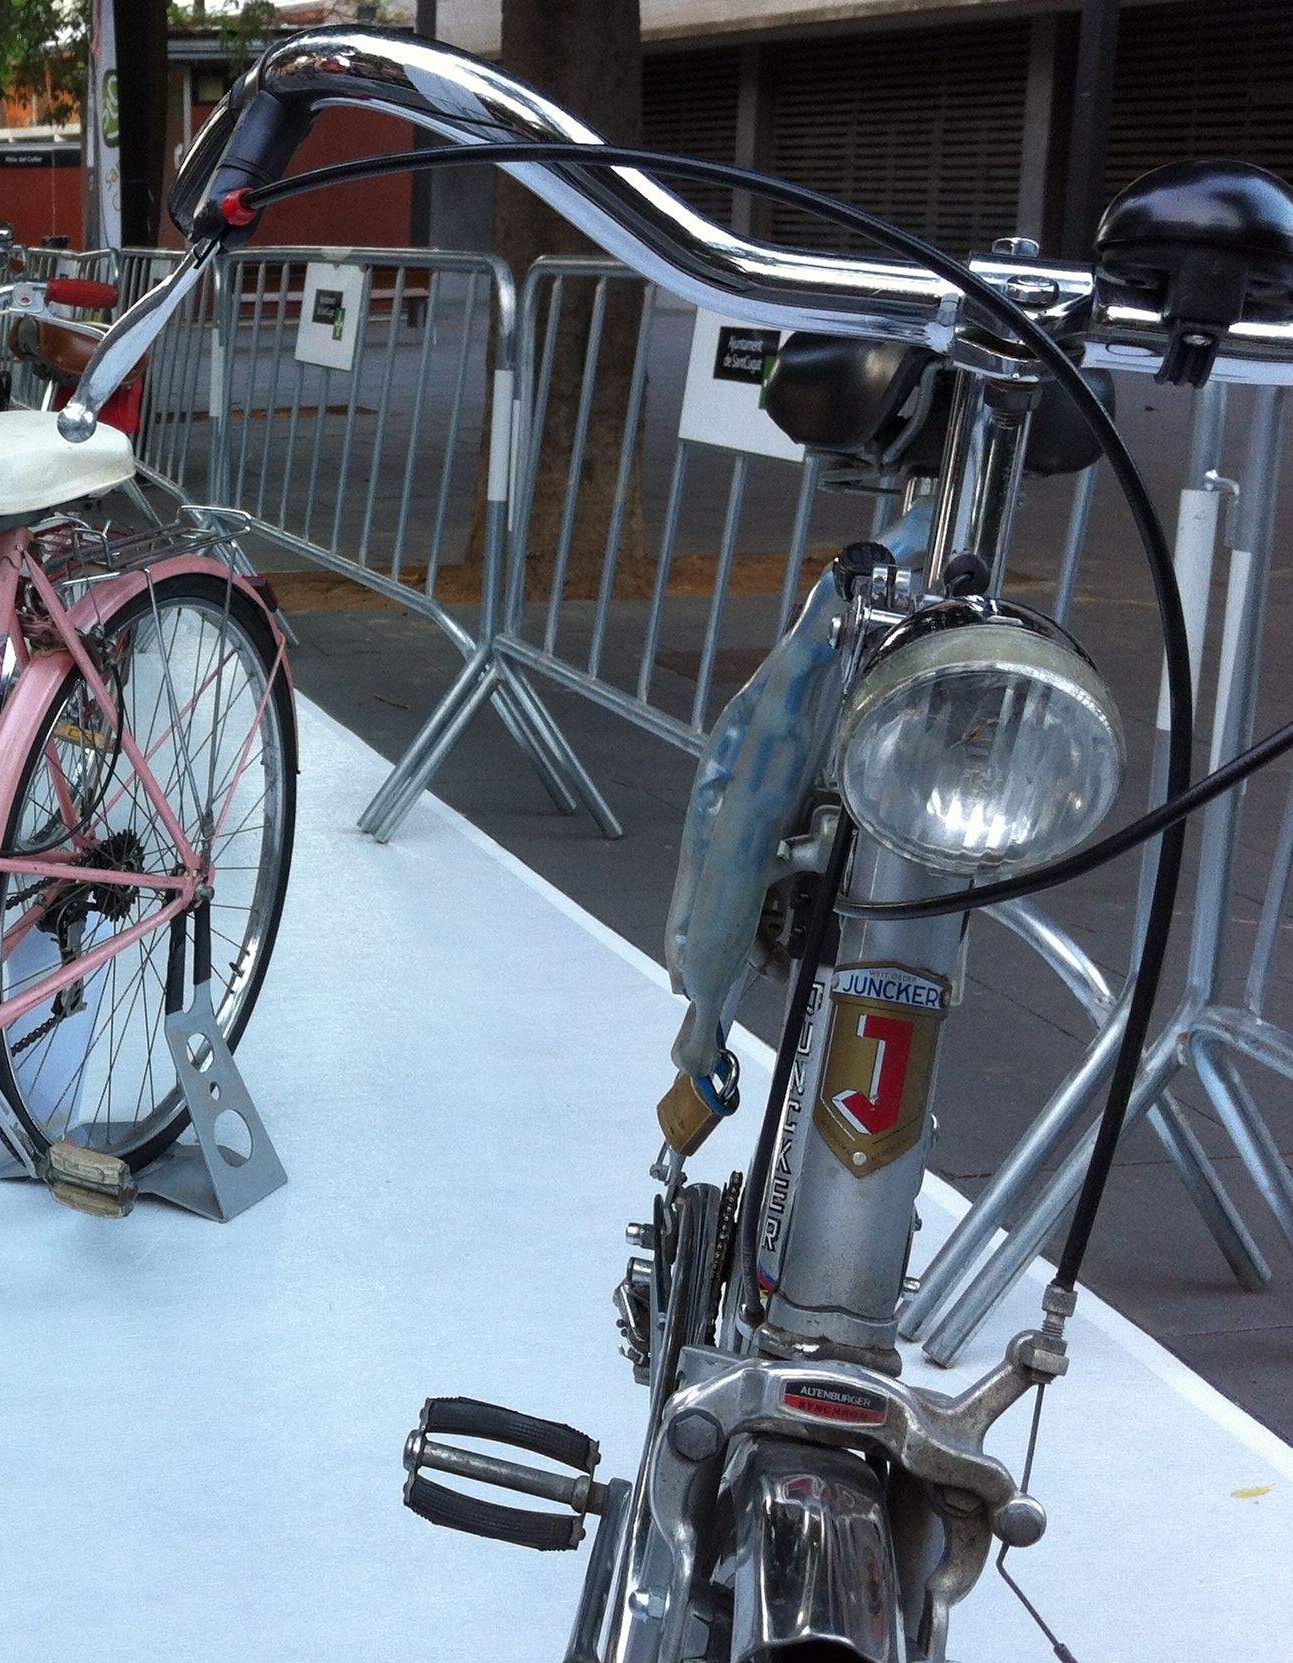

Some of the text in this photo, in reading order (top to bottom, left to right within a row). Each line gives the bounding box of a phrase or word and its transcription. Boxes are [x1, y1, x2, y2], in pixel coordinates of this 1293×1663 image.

[843, 974, 938, 1007] JUNCKER
[832, 1013, 914, 1135] J
[800, 1385, 873, 1407] ALTENBURGER
